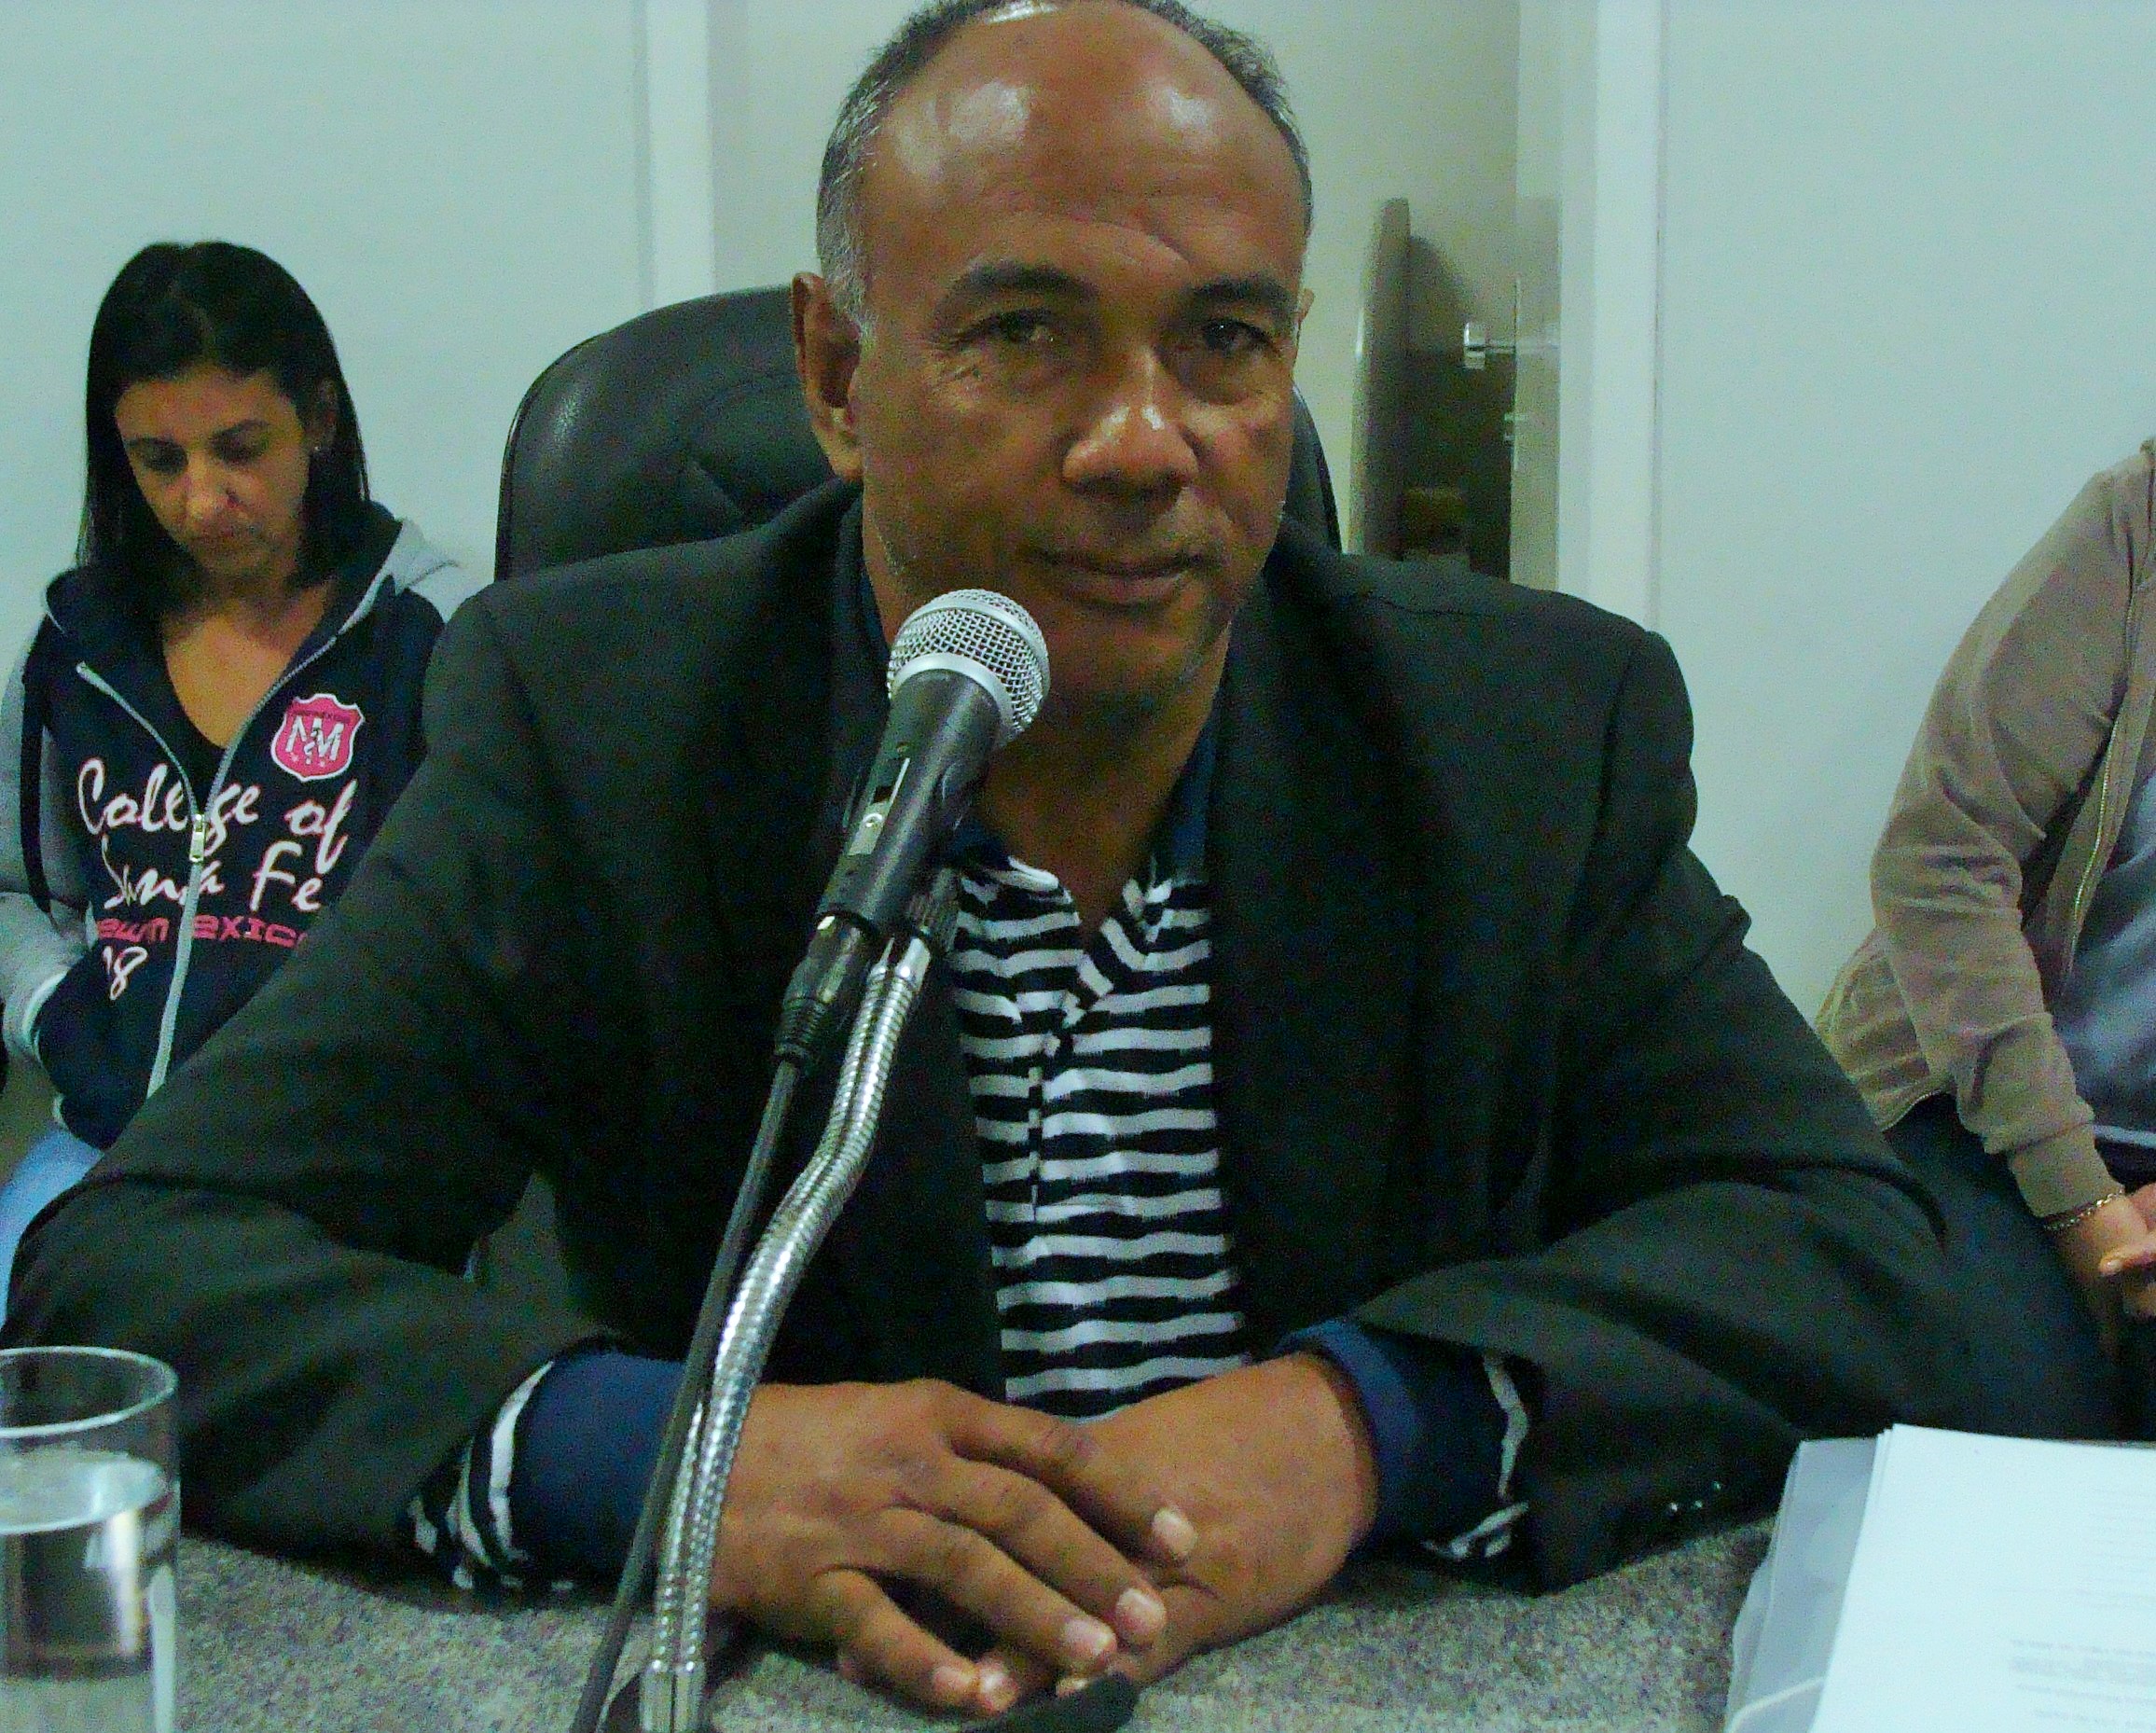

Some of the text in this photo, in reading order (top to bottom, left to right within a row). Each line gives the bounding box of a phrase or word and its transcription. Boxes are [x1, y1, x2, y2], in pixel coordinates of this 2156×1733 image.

[78, 757, 358, 875] Collge of
[104, 835, 323, 912] Sna Fe
